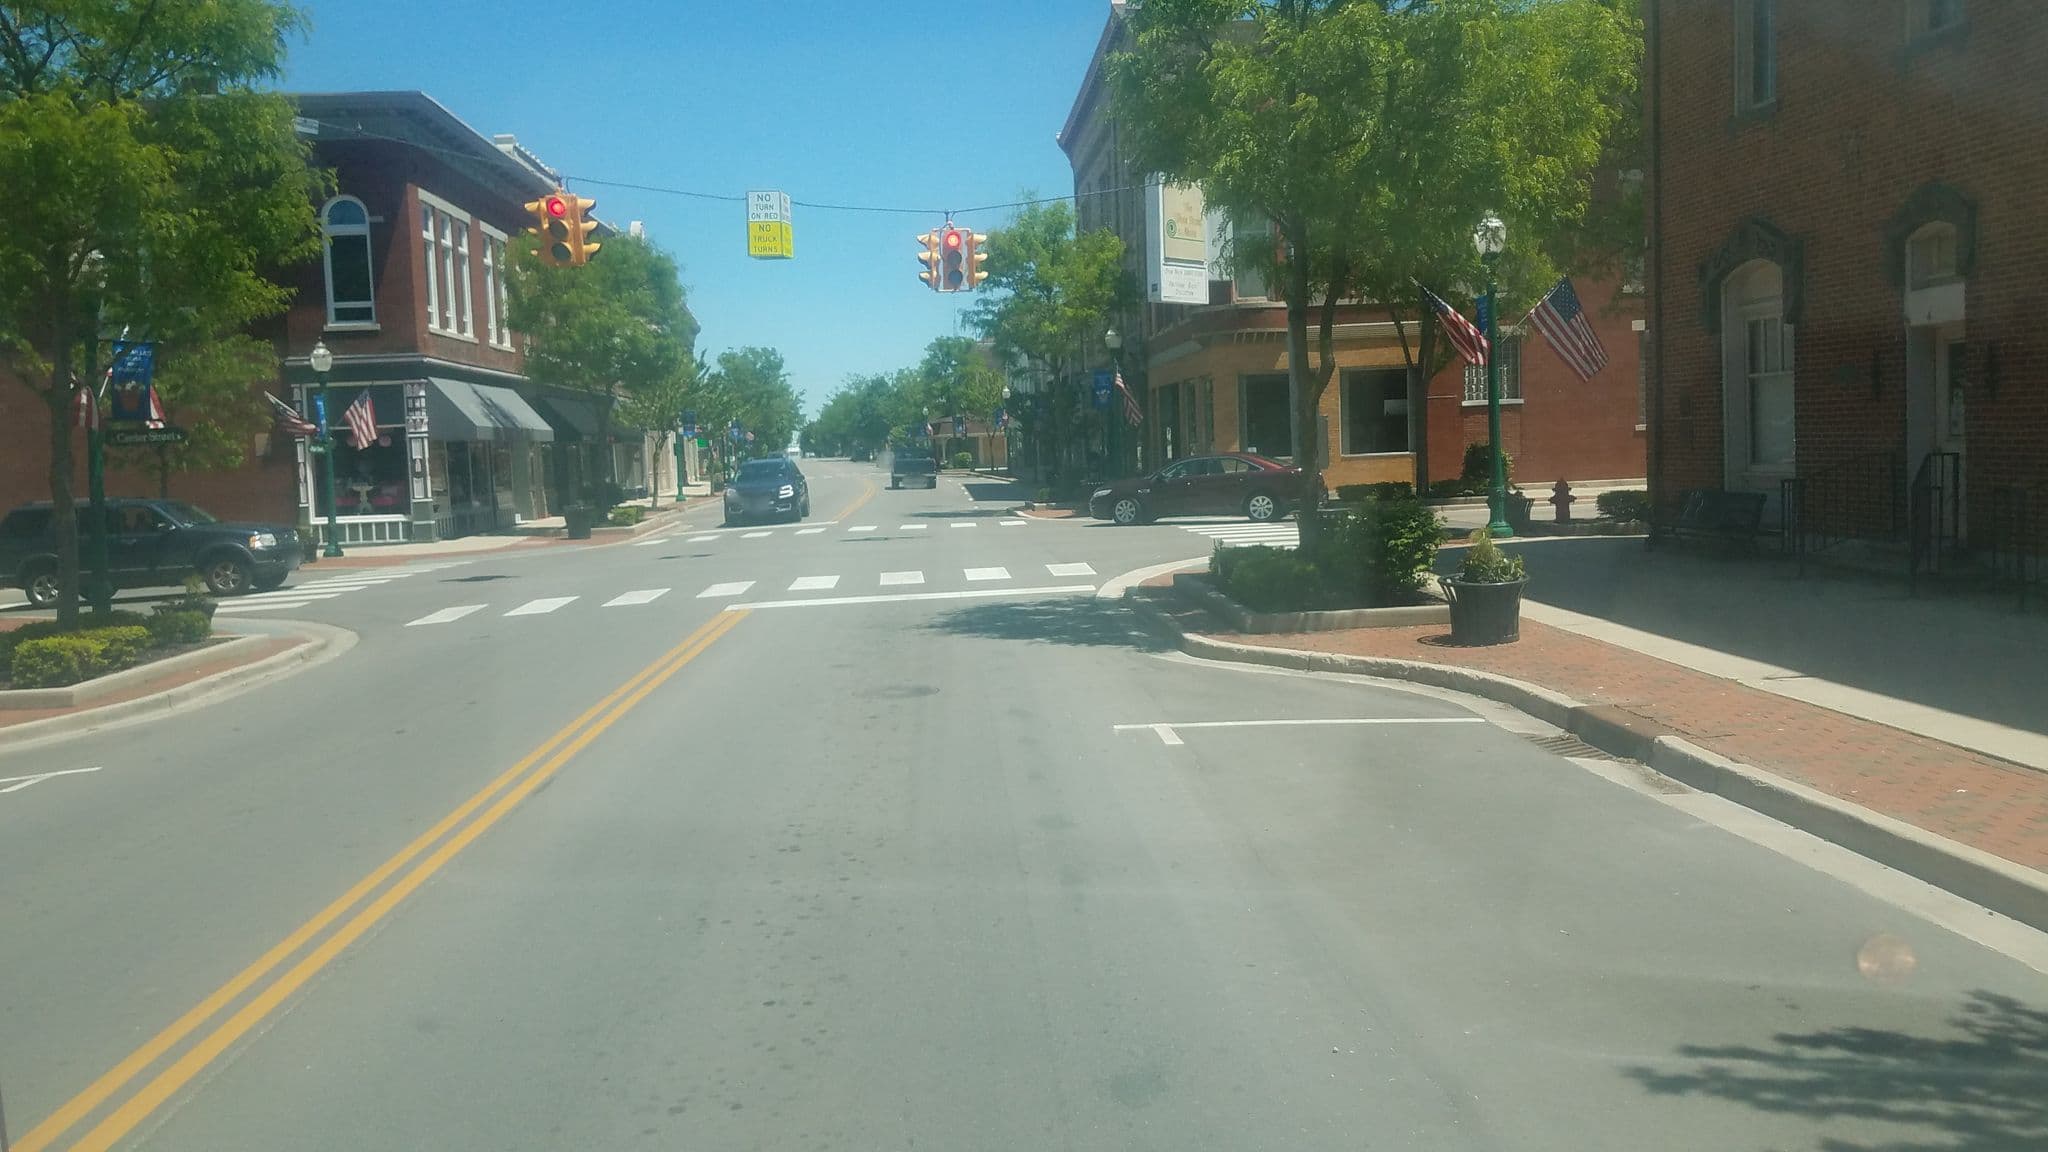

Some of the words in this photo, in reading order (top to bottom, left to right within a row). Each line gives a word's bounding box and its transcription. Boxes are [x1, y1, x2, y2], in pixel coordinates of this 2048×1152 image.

[757, 194, 771, 202] NO
[755, 203, 775, 211] TURN
[751, 212, 761, 220] ON
[764, 212, 778, 220] RED
[758, 224, 771, 232] NO
[753, 235, 778, 243] TRUCK
[754, 245, 778, 253] TURNS
